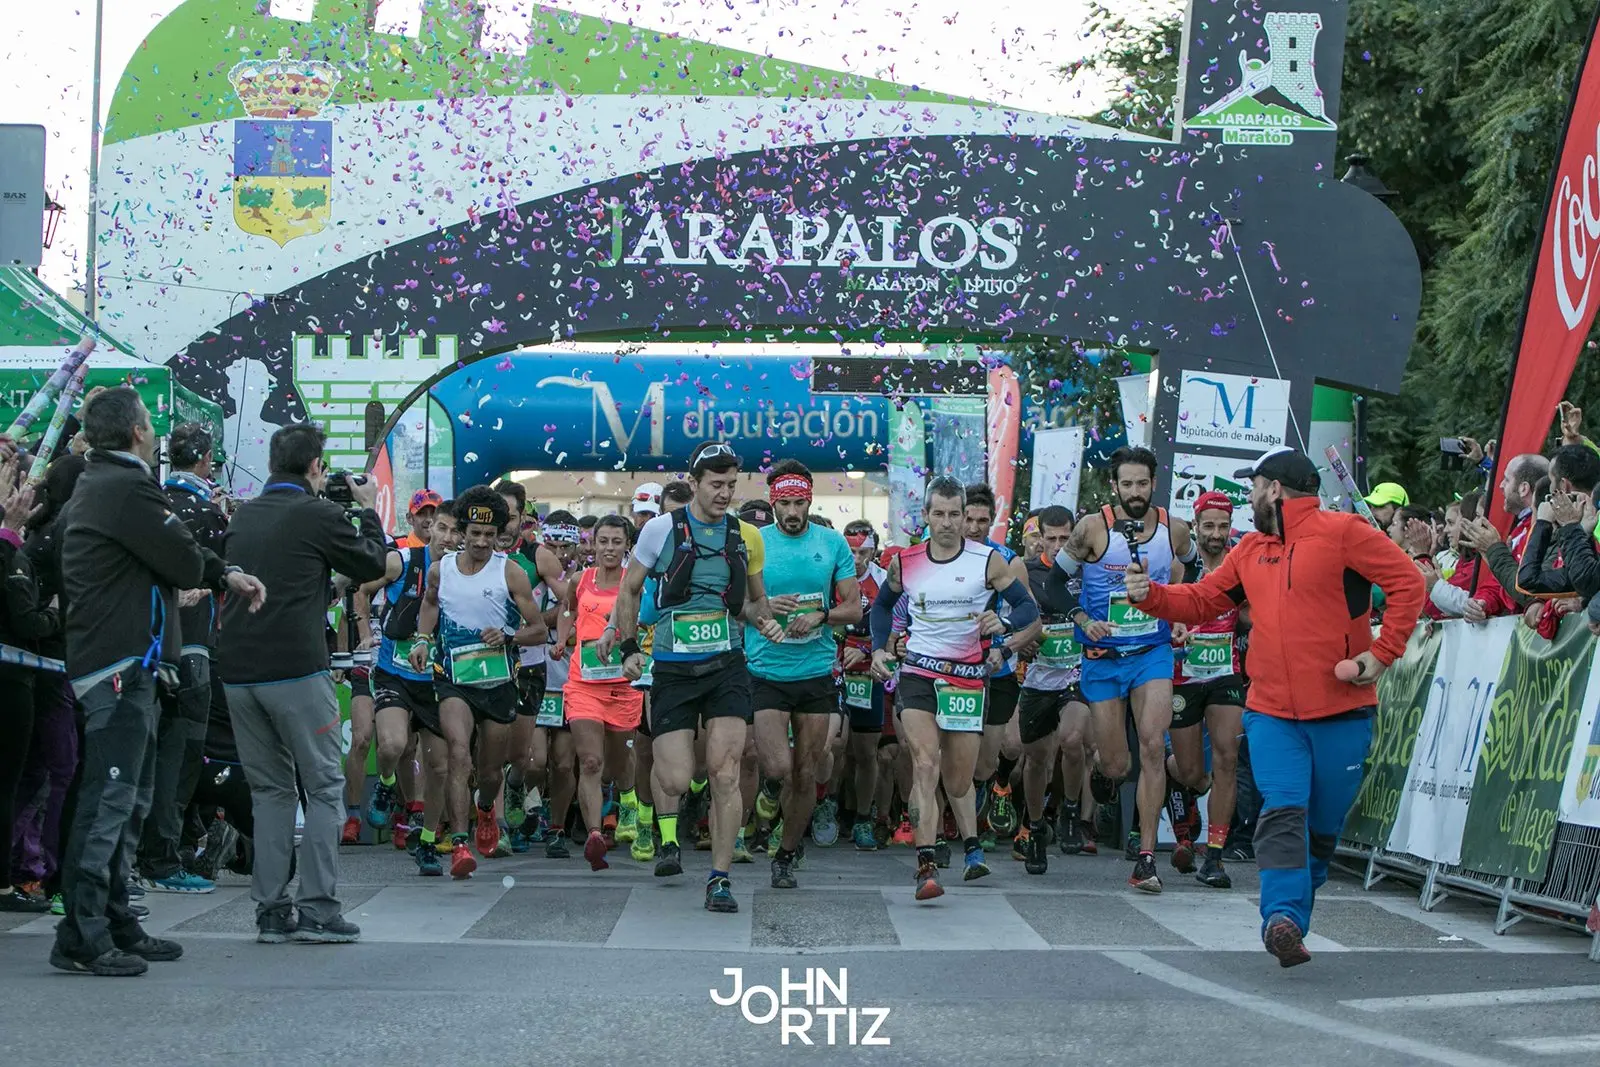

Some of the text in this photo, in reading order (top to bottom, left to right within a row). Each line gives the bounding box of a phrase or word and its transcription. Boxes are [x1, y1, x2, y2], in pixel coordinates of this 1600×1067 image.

[1216, 113, 1302, 126] JARAPALOS
[598, 203, 1022, 270] JARAPALOS
[1180, 426, 1282, 447] diputación de málaga
[689, 623, 721, 642] 380
[1053, 639, 1072, 654] 73
[1199, 648, 1225, 664] 400
[479, 660, 488, 676] 1
[953, 664, 984, 677] MAX
[948, 696, 976, 713] 509
